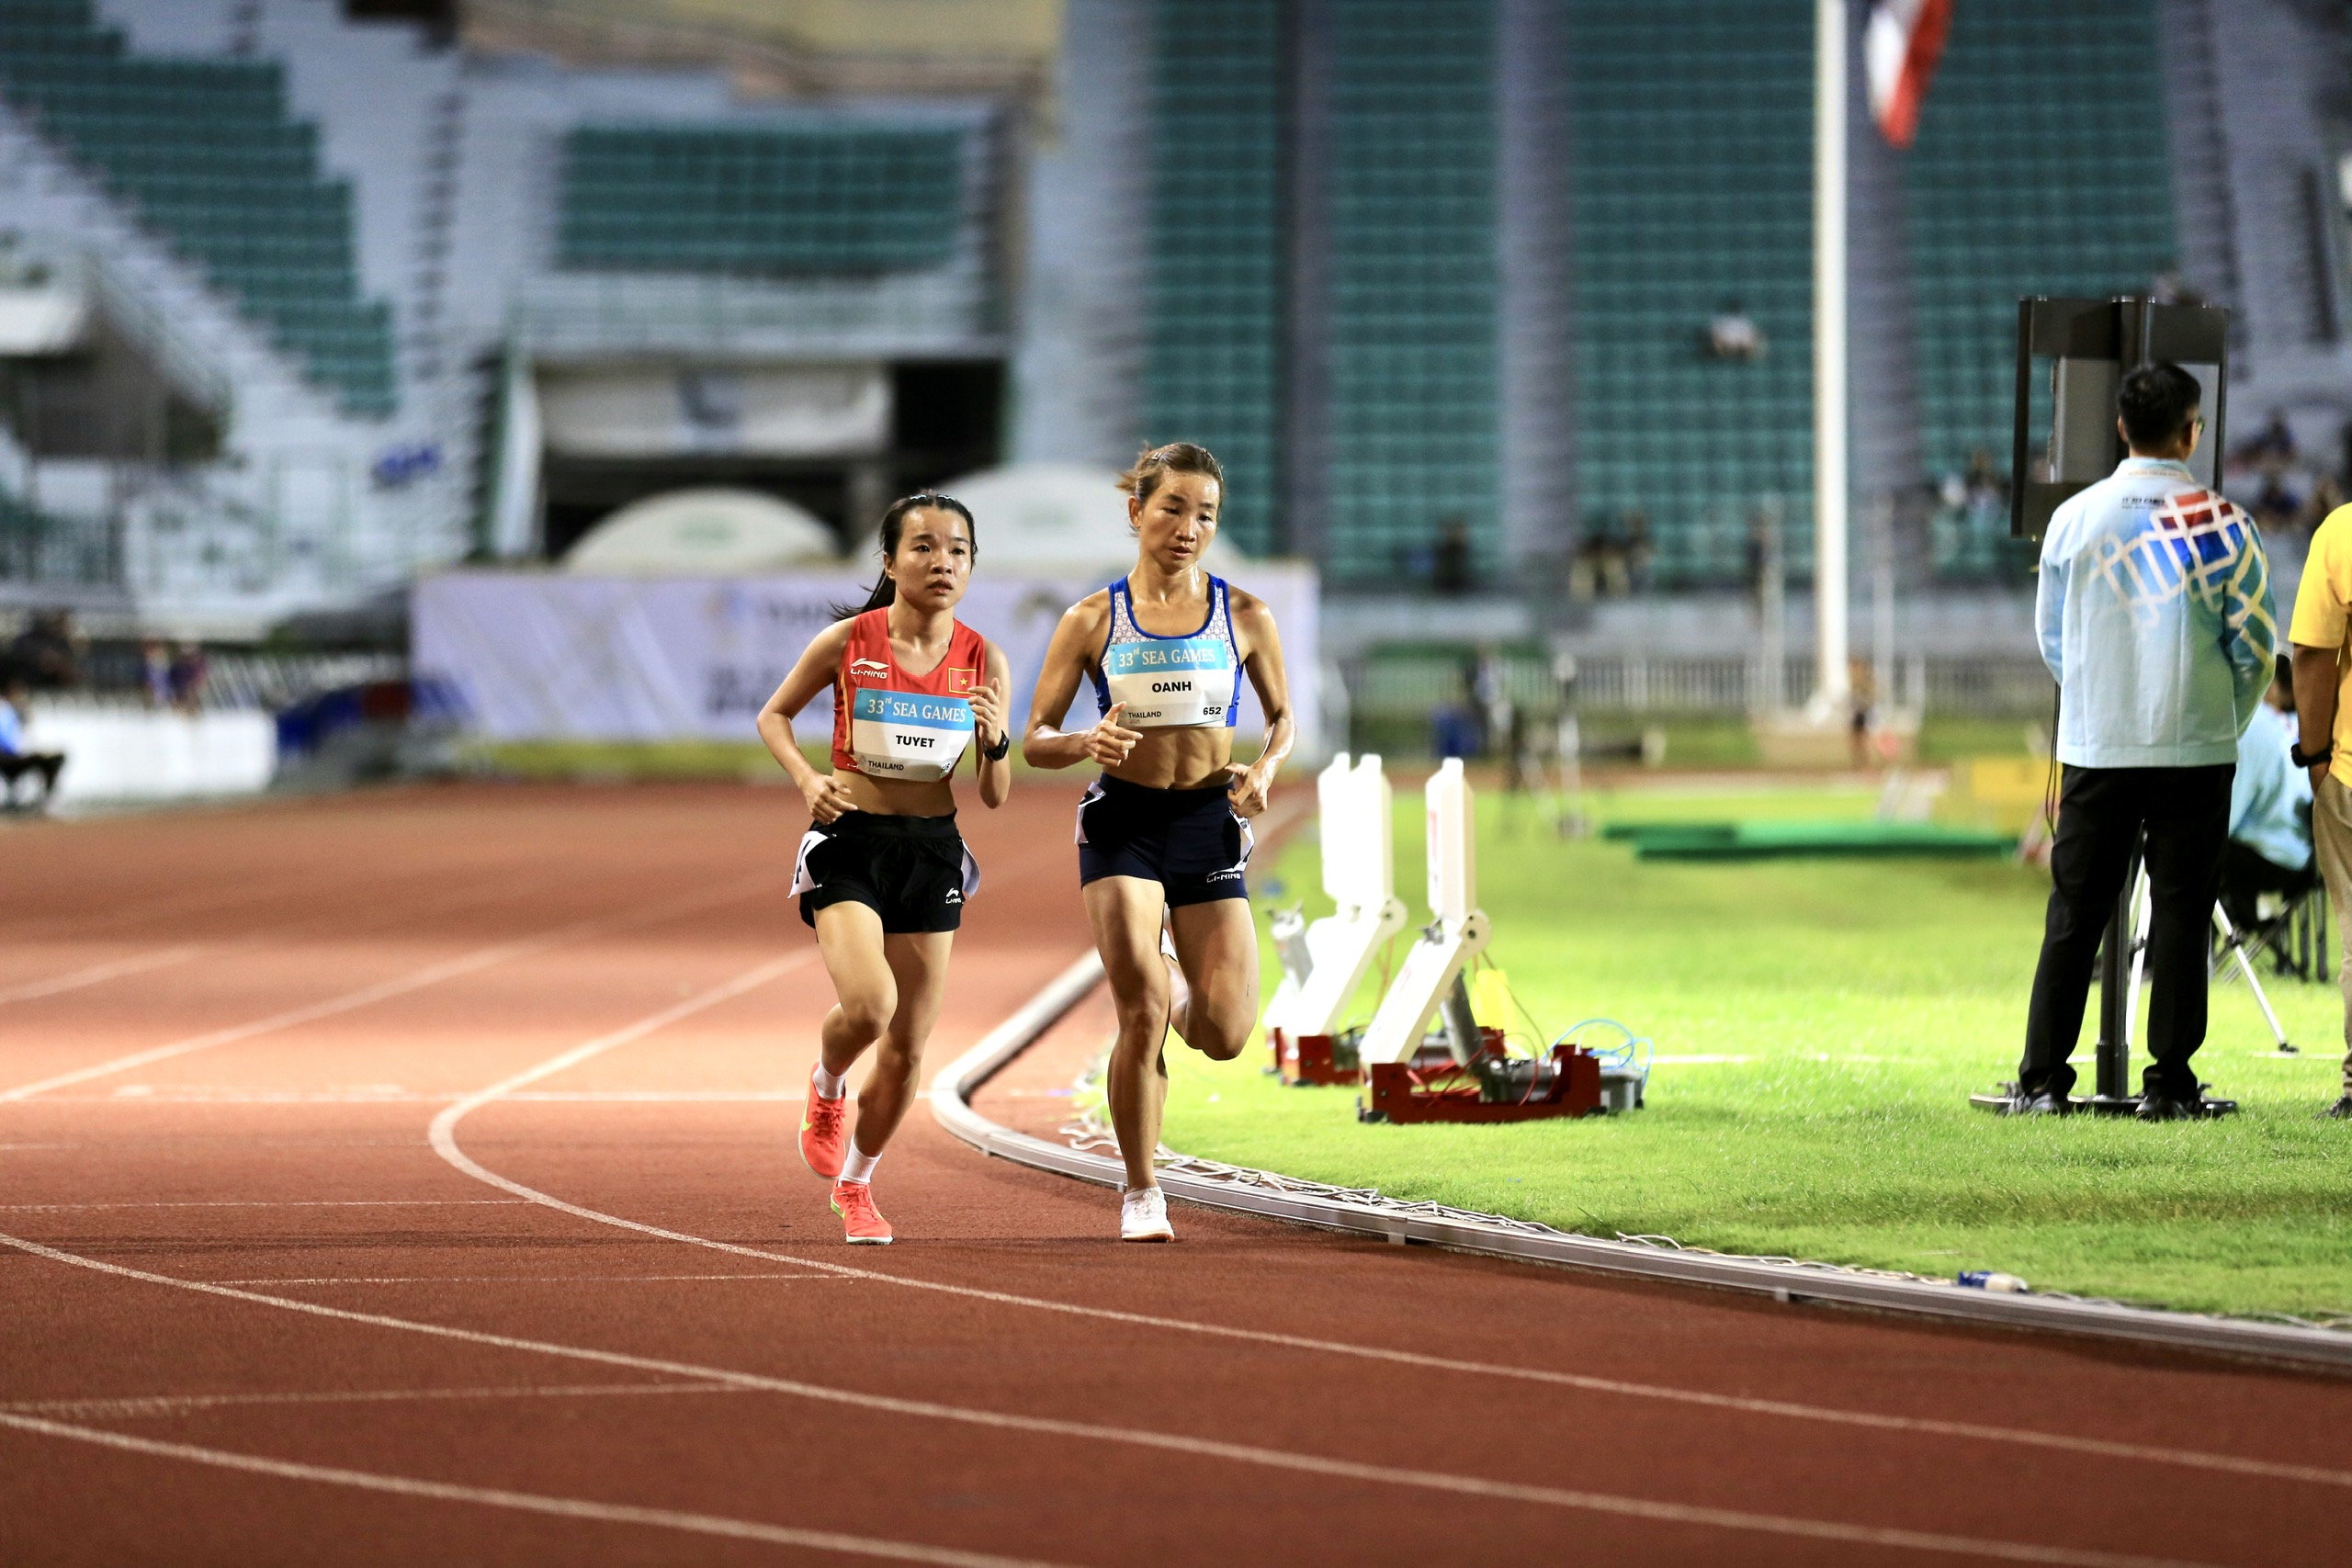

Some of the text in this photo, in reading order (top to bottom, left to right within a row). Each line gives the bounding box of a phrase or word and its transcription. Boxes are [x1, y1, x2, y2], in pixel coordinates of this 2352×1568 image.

[1142, 650, 1168, 665] SEA
[1170, 649, 1216, 663] GAMES
[850, 668, 888, 679] LI-NING
[1151, 681, 1192, 694] OANH
[893, 702, 918, 718] SEA
[922, 705, 967, 723] GAMES
[1127, 711, 1162, 719] THAILAND
[1203, 706, 1222, 716] 652
[895, 735, 935, 749] TUYET
[867, 760, 904, 771] THAILAND
[1206, 874, 1241, 883] LI-NING
